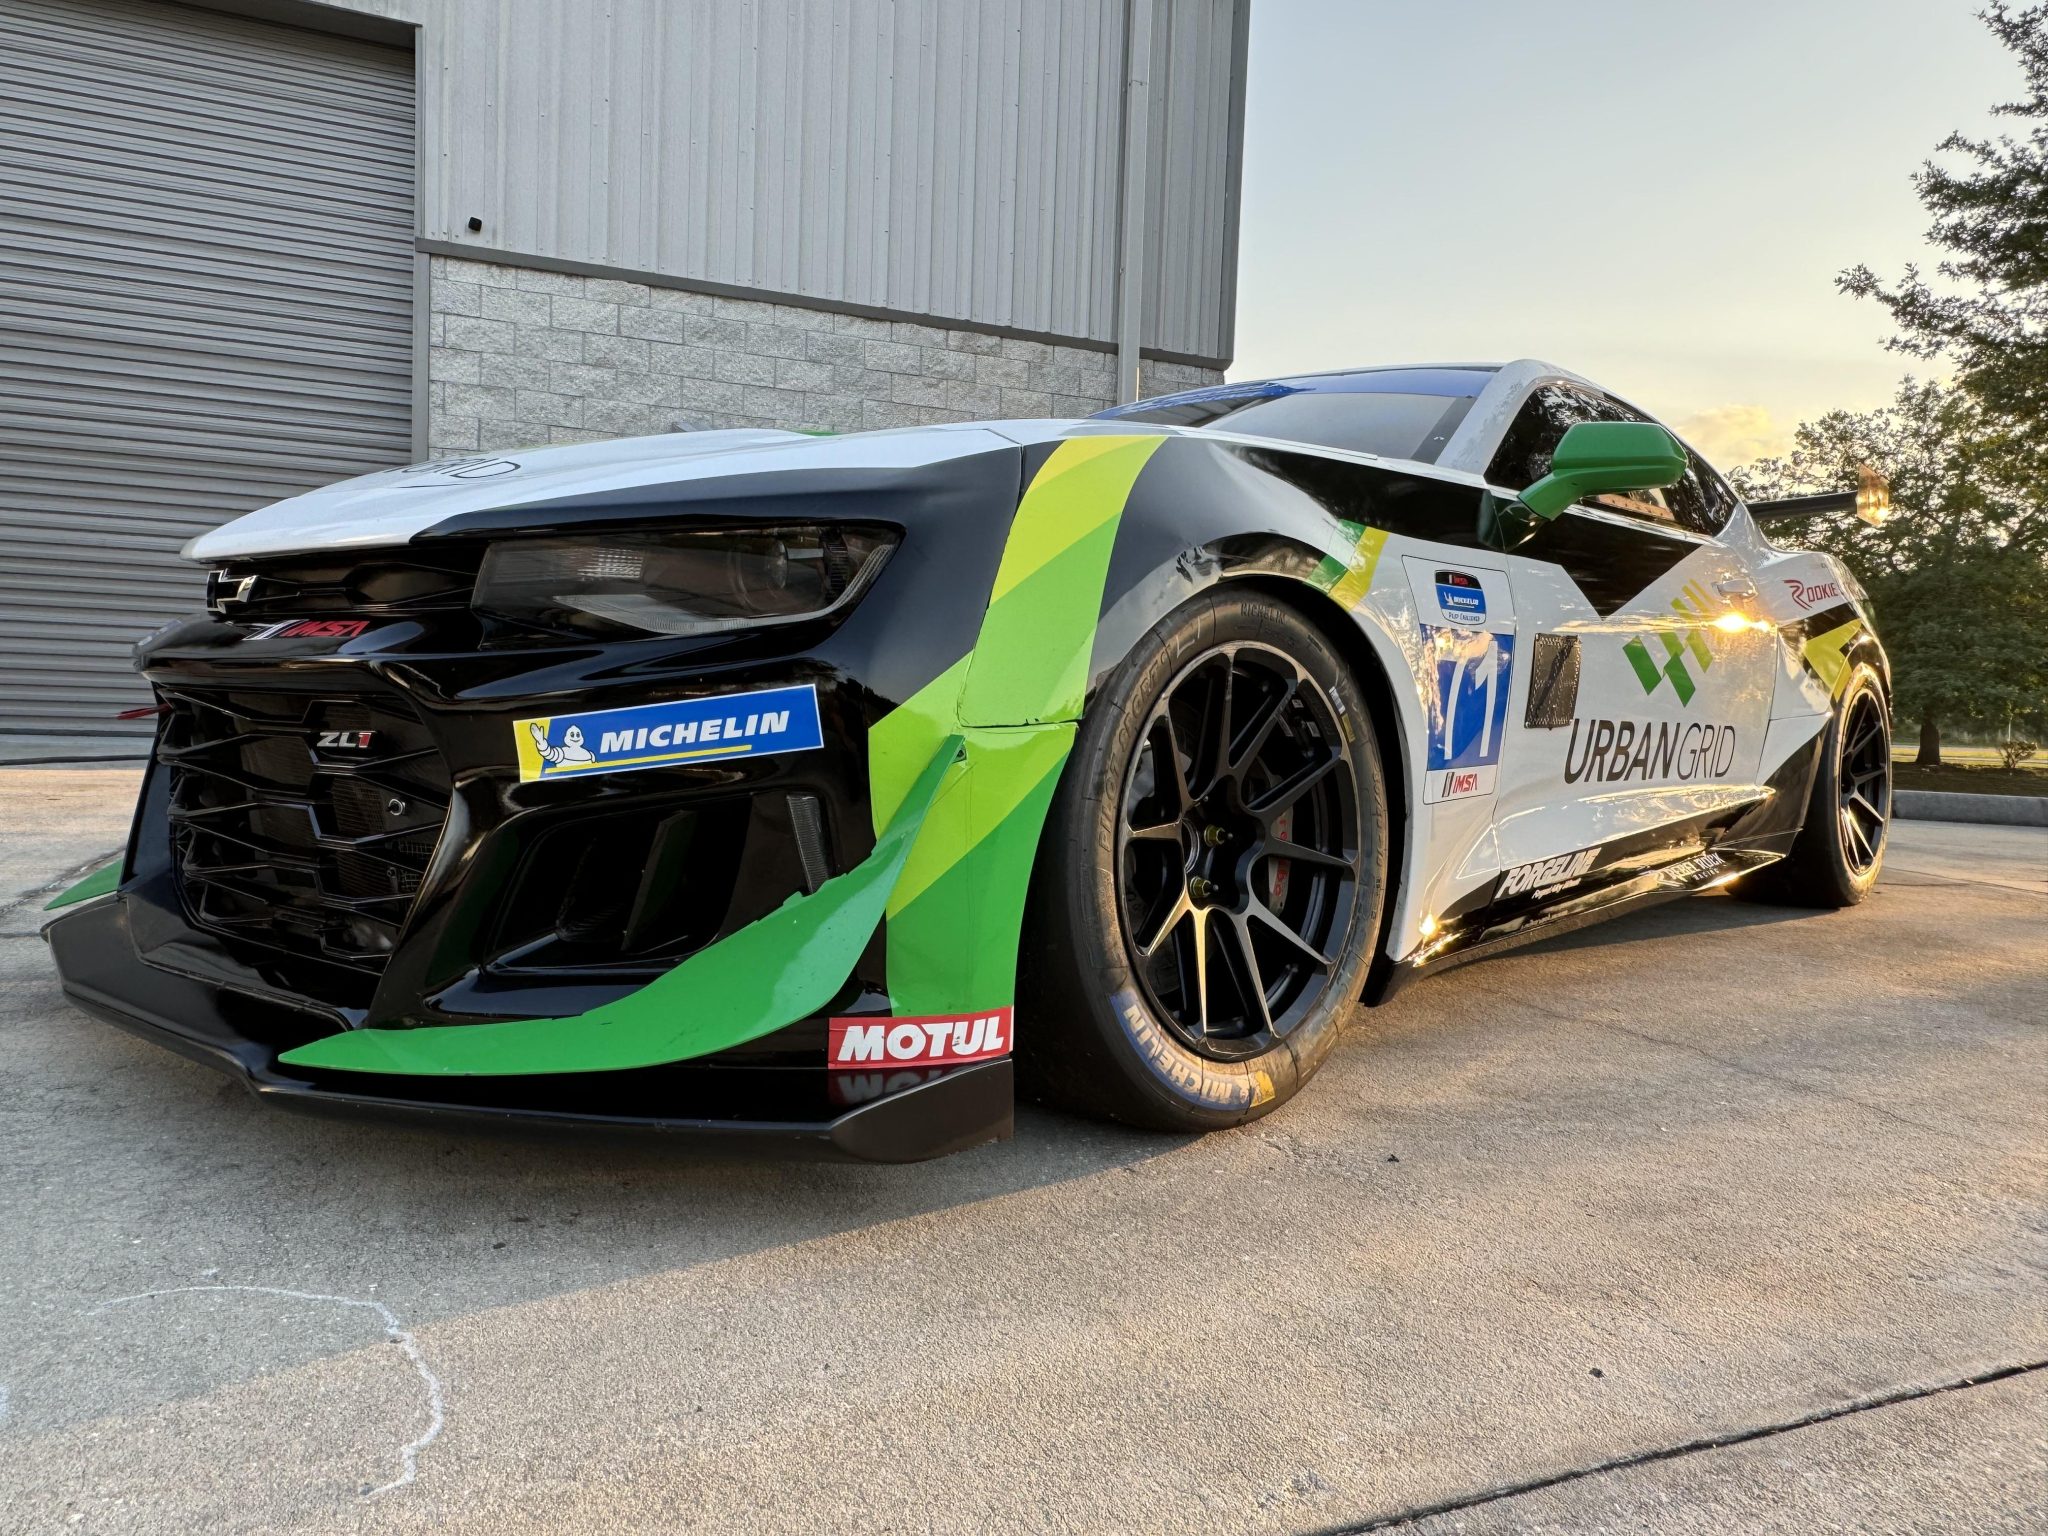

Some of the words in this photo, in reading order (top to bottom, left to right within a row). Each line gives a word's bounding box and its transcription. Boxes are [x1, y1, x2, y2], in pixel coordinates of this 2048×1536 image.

[1783, 579, 1839, 611] ROOKIE
[280, 620, 370, 637] IMSA
[1434, 638, 1498, 761] 71
[316, 730, 376, 749] ZL1
[600, 710, 790, 754] MICHELIN
[1453, 773, 1478, 794] IMSA
[1494, 847, 1602, 899] FORGELINE
[1693, 852, 1726, 870] ROCK
[837, 1016, 1004, 1061] MOTUL
[1123, 1004, 1233, 1104] MICHELIN
